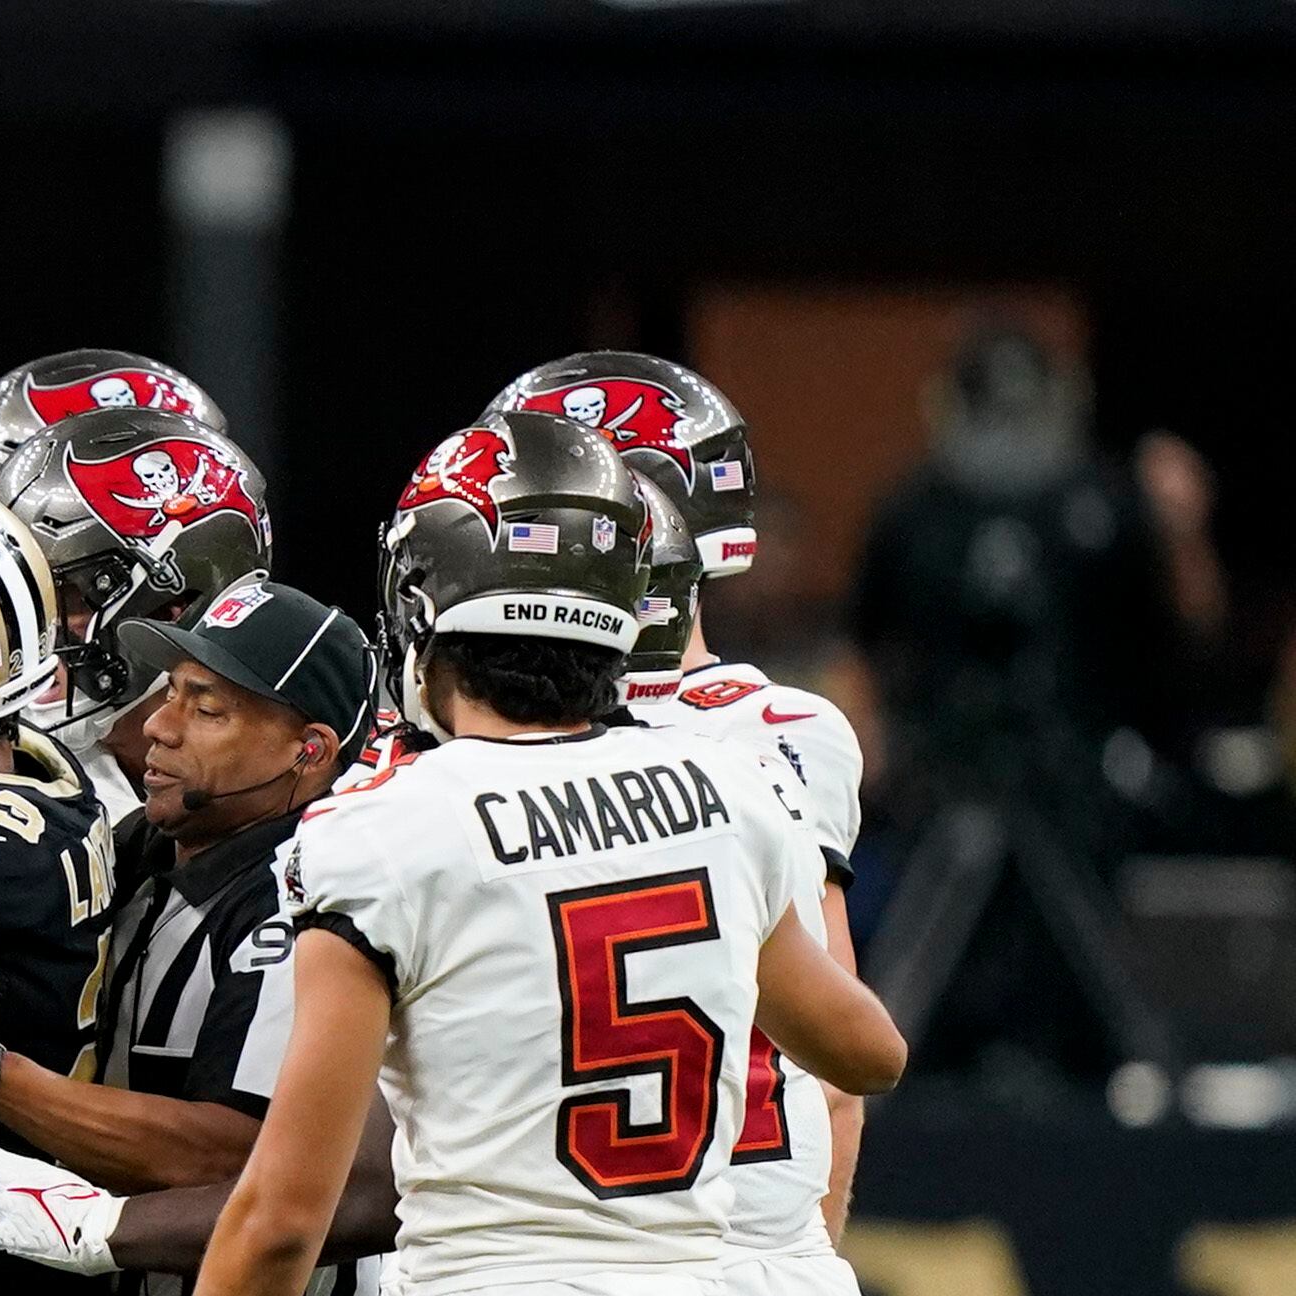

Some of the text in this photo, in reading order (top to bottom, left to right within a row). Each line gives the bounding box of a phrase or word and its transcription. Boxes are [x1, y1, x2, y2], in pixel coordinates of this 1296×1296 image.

[503, 604, 625, 635] END RACISM
[473, 759, 731, 866] CAMARDA
[546, 866, 725, 1200] 5
